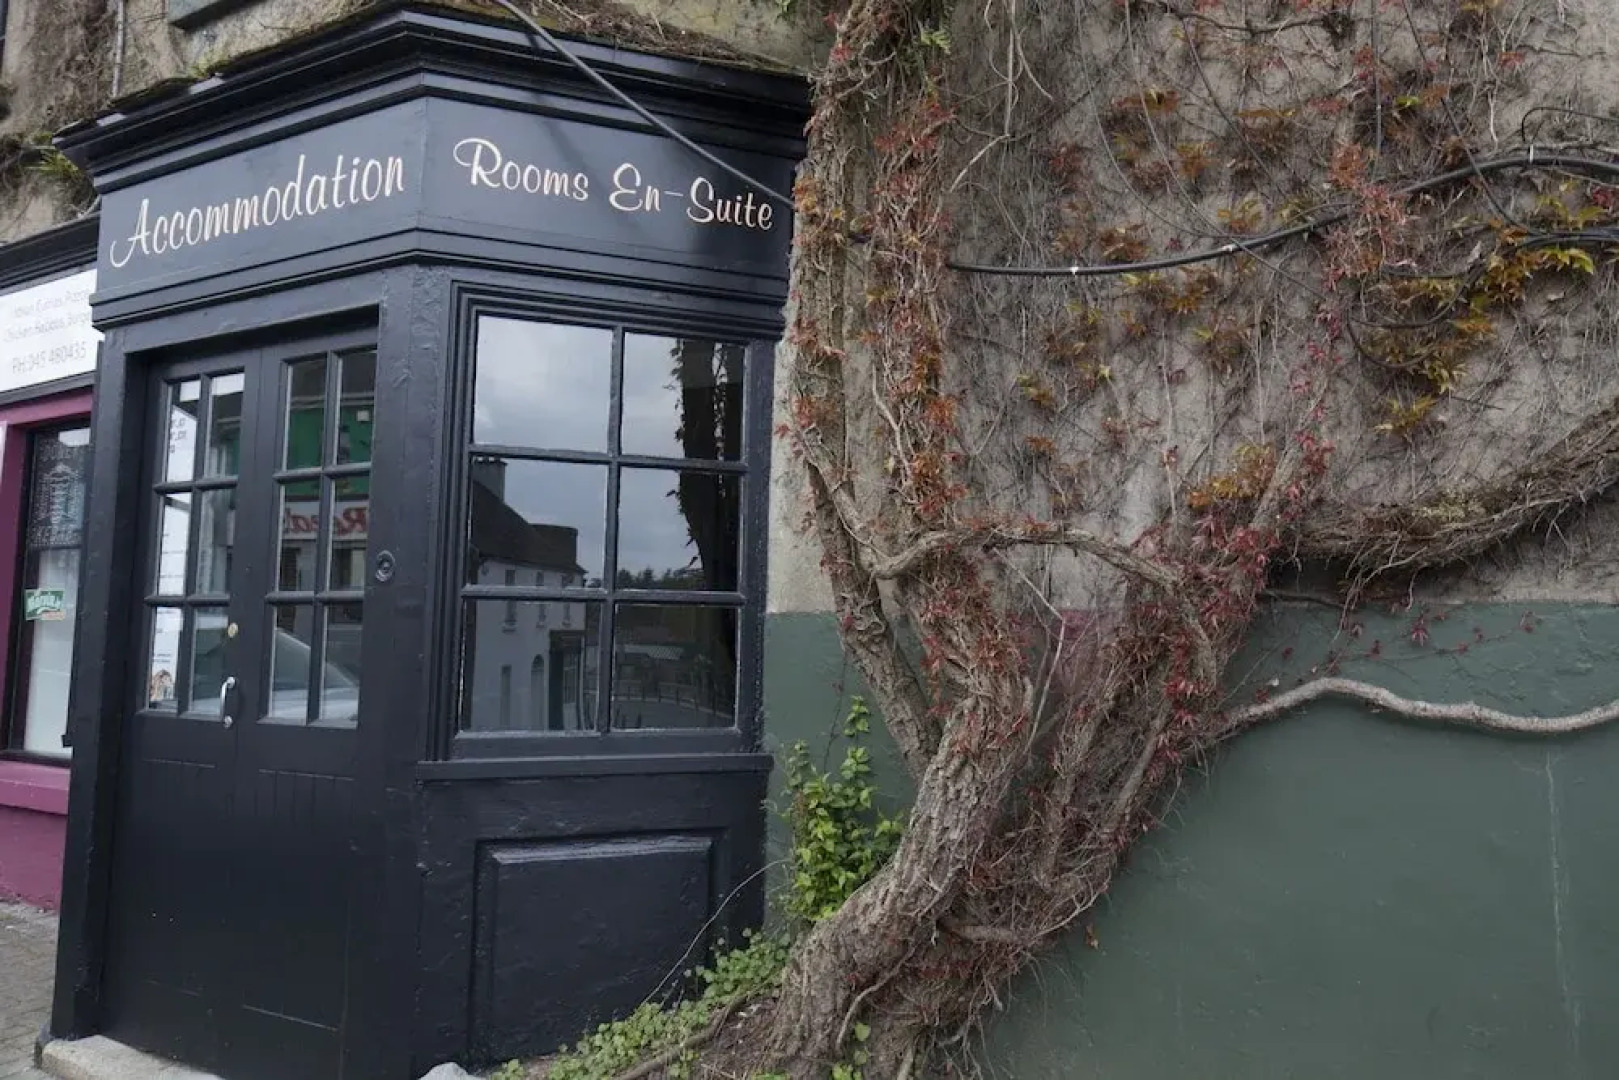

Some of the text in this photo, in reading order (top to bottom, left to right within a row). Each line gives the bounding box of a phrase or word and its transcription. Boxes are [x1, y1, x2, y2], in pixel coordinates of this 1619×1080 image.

[110, 153, 405, 269] Accommodation
[452, 136, 774, 230] Rooms En-Suite
